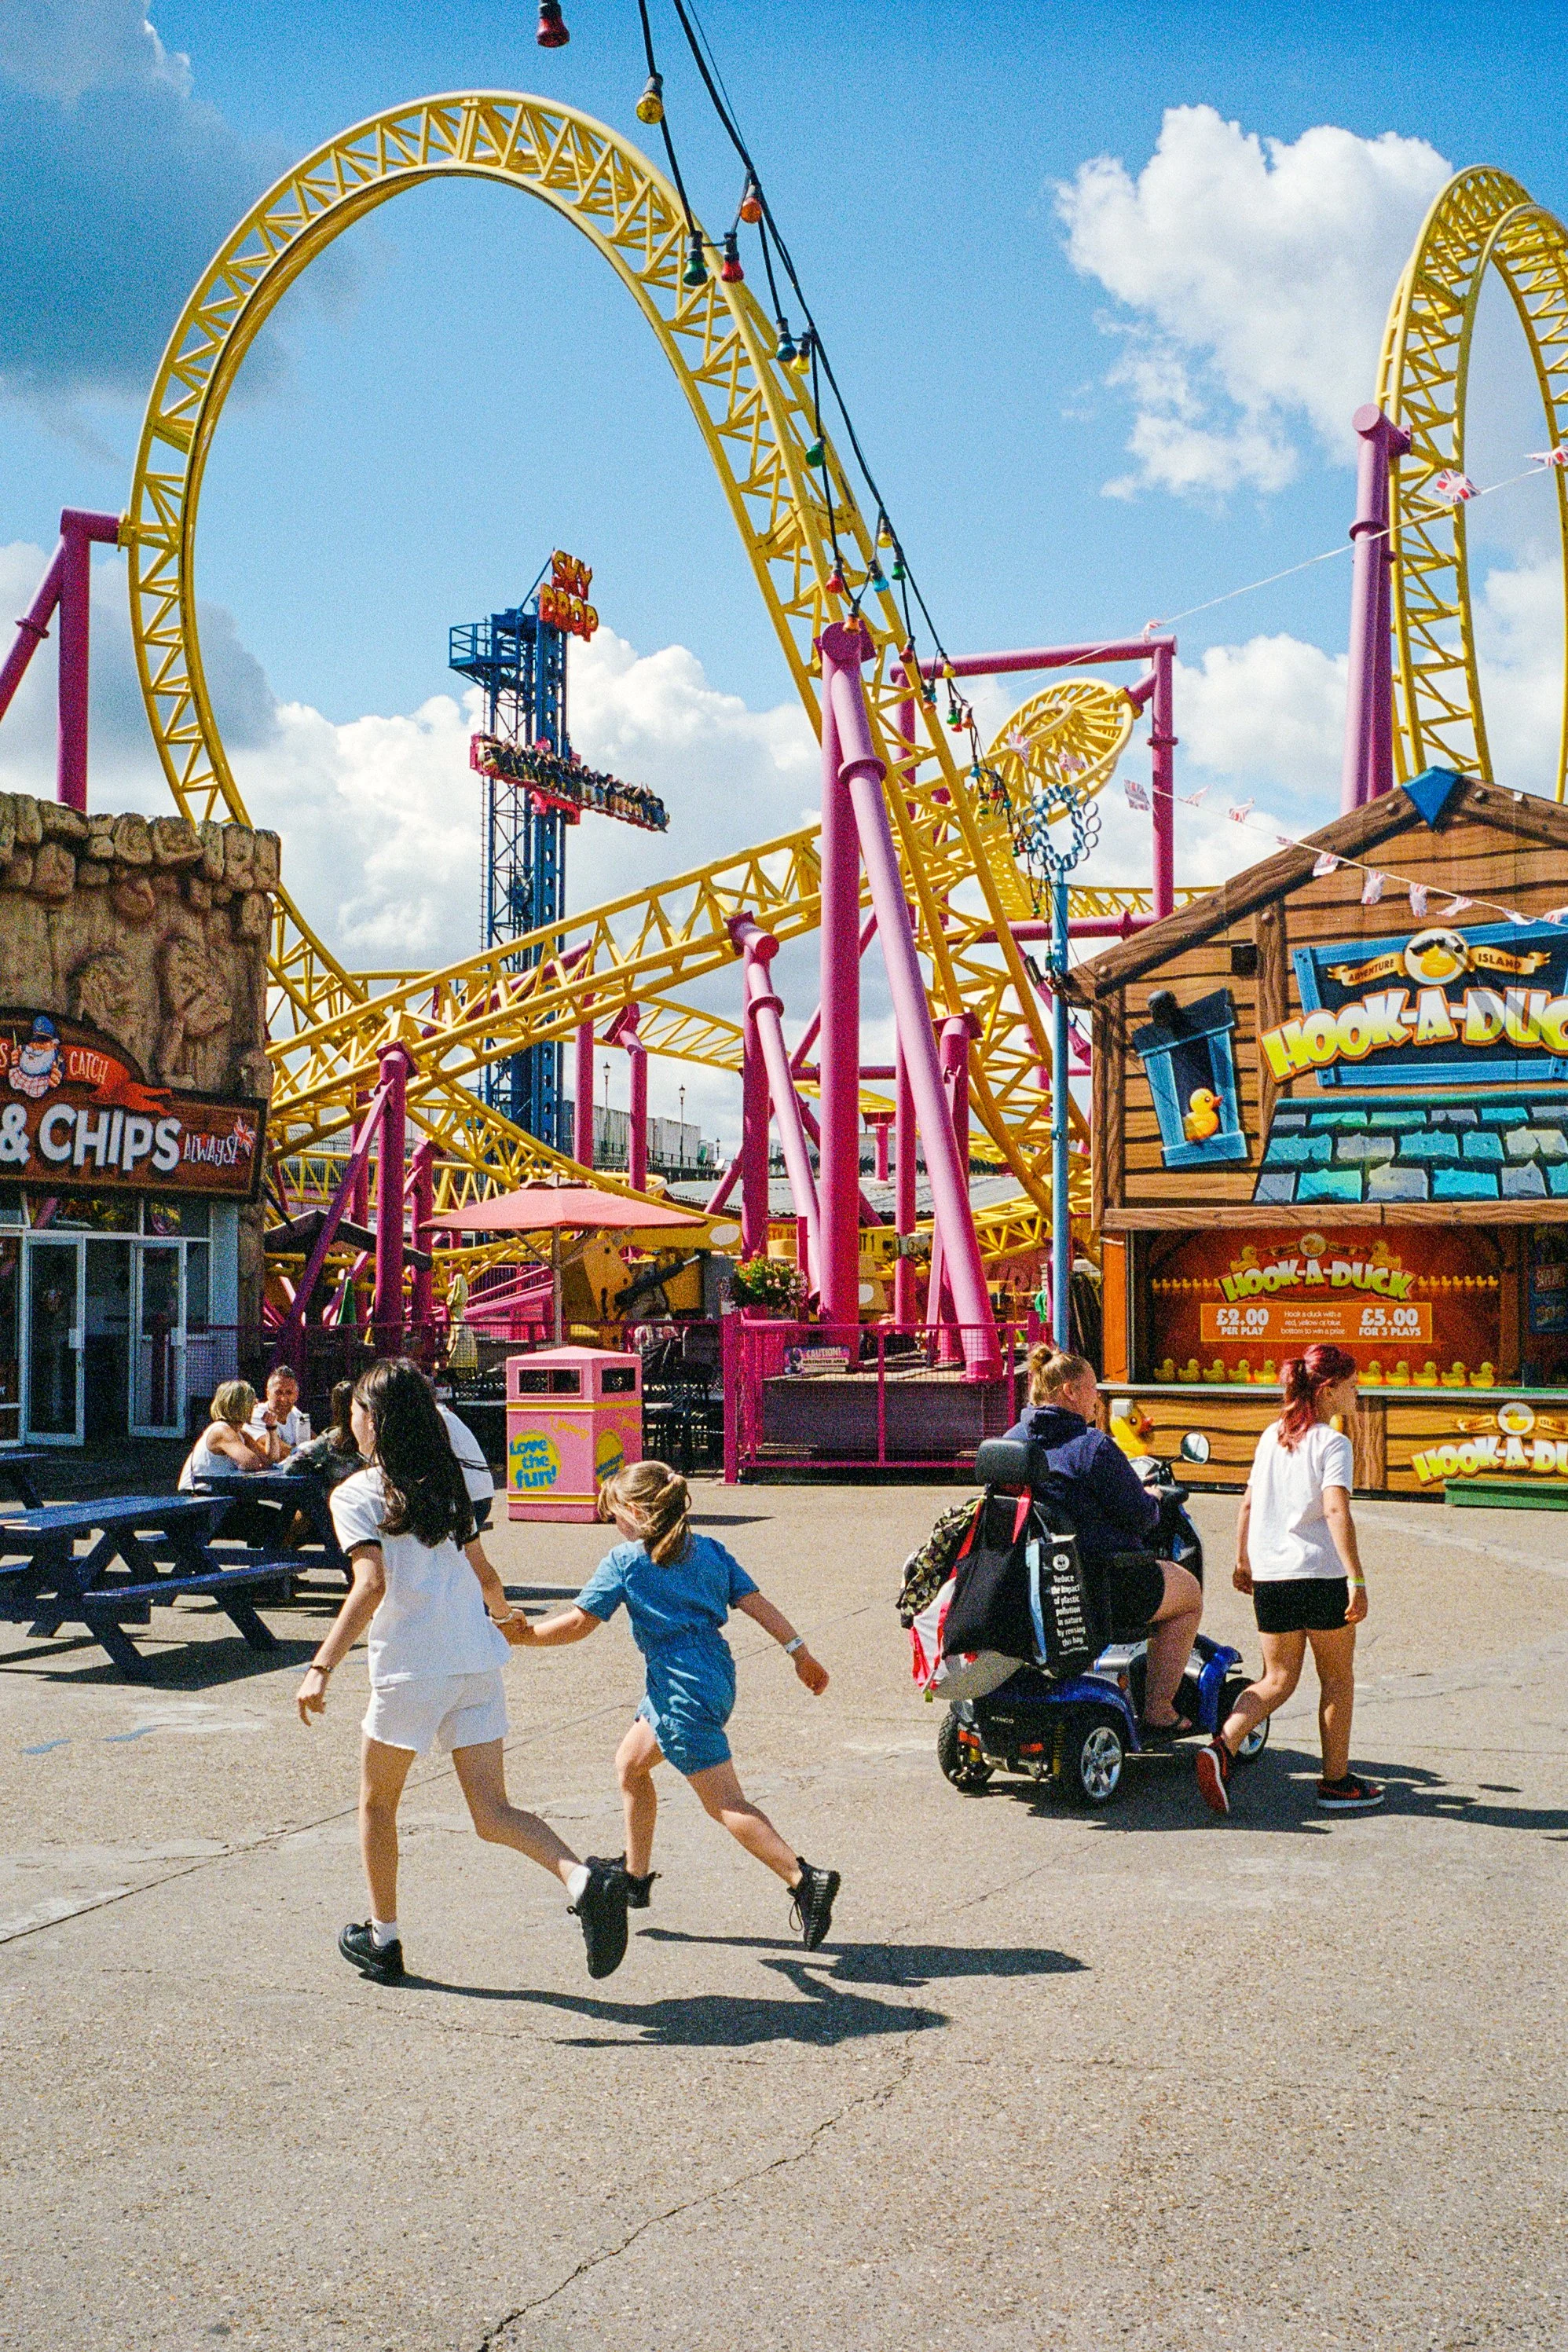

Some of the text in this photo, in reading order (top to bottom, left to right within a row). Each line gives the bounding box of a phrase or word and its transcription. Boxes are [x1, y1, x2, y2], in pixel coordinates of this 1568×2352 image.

[551, 550, 593, 602] SKY
[539, 583, 599, 643] DROP
[1348, 953, 1522, 983] ADVENTURE ISLAND
[68, 1050, 109, 1084] CATCH
[0, 1103, 182, 1171] & CHIPS
[1220, 1258, 1413, 1302] HOOK-A-DUCK
[1216, 1308, 1269, 1326] £2.00
[1361, 1308, 1419, 1327] £5.00
[1221, 1326, 1265, 1335] PER PLAY
[1358, 1327, 1421, 1336] FOR 3 PLAYS
[510, 1439, 548, 1456] Love
[521, 1455, 550, 1470] the
[515, 1465, 557, 1489] fun!
[1053, 1574, 1075, 1583] Reduce
[1050, 1584, 1080, 1595] the impact
[1053, 1595, 1080, 1606] of plastic
[1055, 1606, 1081, 1617] pollution
[1064, 1617, 1083, 1625] nature
[1057, 1628, 1064, 1637] by
[1062, 1636, 1083, 1647] this bag
